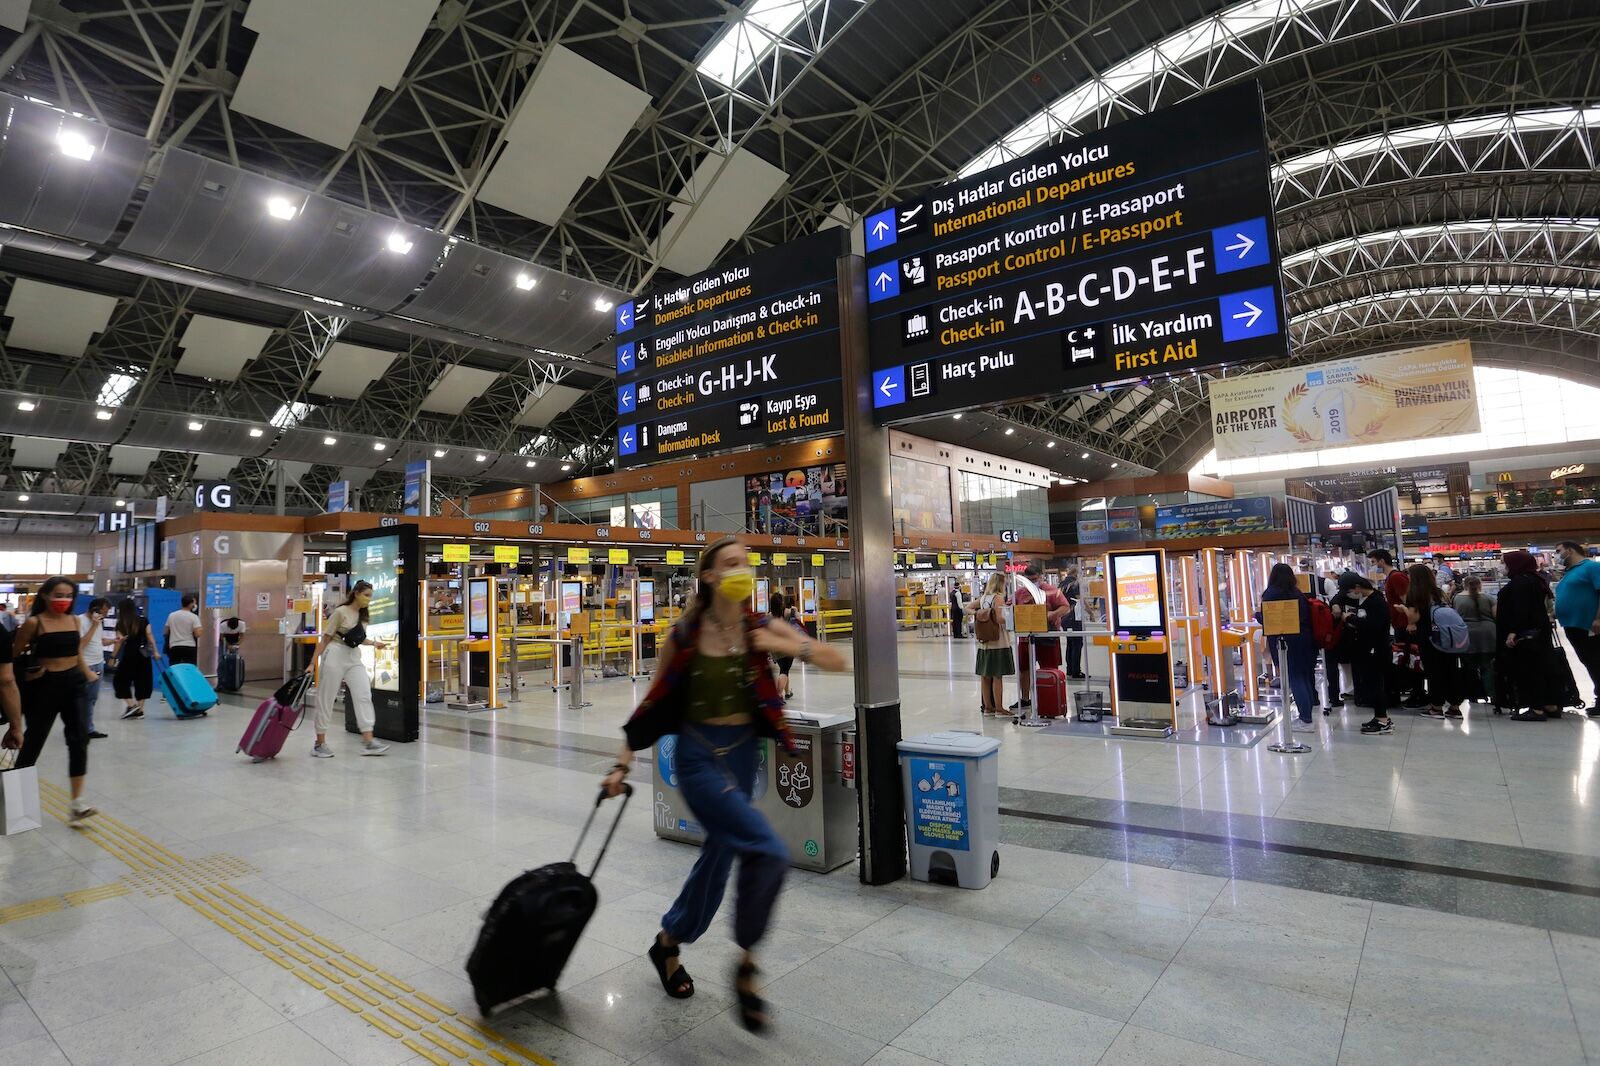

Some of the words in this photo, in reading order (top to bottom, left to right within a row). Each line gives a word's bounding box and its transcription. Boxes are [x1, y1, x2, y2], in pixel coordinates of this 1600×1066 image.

[932, 198, 955, 216] Dış
[958, 180, 1005, 208] Hatlar
[1010, 161, 1058, 190] Giden
[1060, 142, 1110, 170] Yolcu
[934, 196, 1032, 238] International
[1036, 161, 1136, 207] Departures
[936, 236, 1001, 270] Pasaport
[1004, 216, 1066, 249] Kontrol
[1070, 213, 1077, 230] /
[1082, 182, 1186, 226] E-Pasaport
[936, 258, 1001, 292] Passport
[1004, 240, 1066, 272] Control
[1070, 238, 1077, 254] /
[1082, 210, 1184, 251] E-Passport
[654, 294, 662, 311] İç
[664, 287, 690, 306] Hatlar
[692, 274, 720, 295] Giden
[722, 266, 750, 284] Yolcu
[1013, 246, 1207, 326] A-B-C-D-E-F
[655, 304, 695, 326] Domestic
[697, 284, 752, 312] Departures
[938, 295, 1004, 324] Check-in
[656, 330, 684, 352] Engelli
[686, 320, 710, 340] Yolcu
[712, 311, 756, 332] Danışma
[760, 306, 768, 318] &
[771, 292, 820, 316] Check-in
[940, 318, 1005, 348] Check-in
[1112, 324, 1138, 346] İlk
[1142, 310, 1212, 340] Yardım
[656, 346, 694, 368] Disabled
[696, 330, 754, 356] Information
[757, 326, 766, 338] &
[768, 312, 818, 336] Check-in
[942, 359, 977, 381] Harç
[980, 349, 1014, 372] Pulu
[1114, 345, 1158, 372] First
[1162, 339, 1198, 362] Aid
[656, 373, 694, 394] Check-in
[698, 354, 778, 396] G-H-J-K
[657, 391, 695, 411] Check-in
[766, 398, 792, 416] Kayıp
[794, 392, 816, 410] Eşya
[768, 418, 787, 434] Lost
[789, 417, 797, 430] &
[800, 409, 829, 428] Found
[1216, 406, 1275, 425] AIRPORT
[1216, 424, 1228, 434] OF
[1230, 422, 1249, 432] THE
[1251, 419, 1277, 430] YEAR
[1329, 409, 1341, 434] 2019
[658, 420, 688, 437] Danışma
[658, 433, 700, 454] Information
[702, 430, 720, 446] Desk
[210, 485, 231, 508] G
[110, 513, 127, 531] H
[381, 517, 398, 526] G01
[474, 522, 490, 532] G02
[529, 525, 543, 534] G03
[597, 529, 609, 537] G04
[214, 536, 230, 554] G
[1450, 542, 1474, 551] Duty
[1476, 541, 1501, 550] Free
